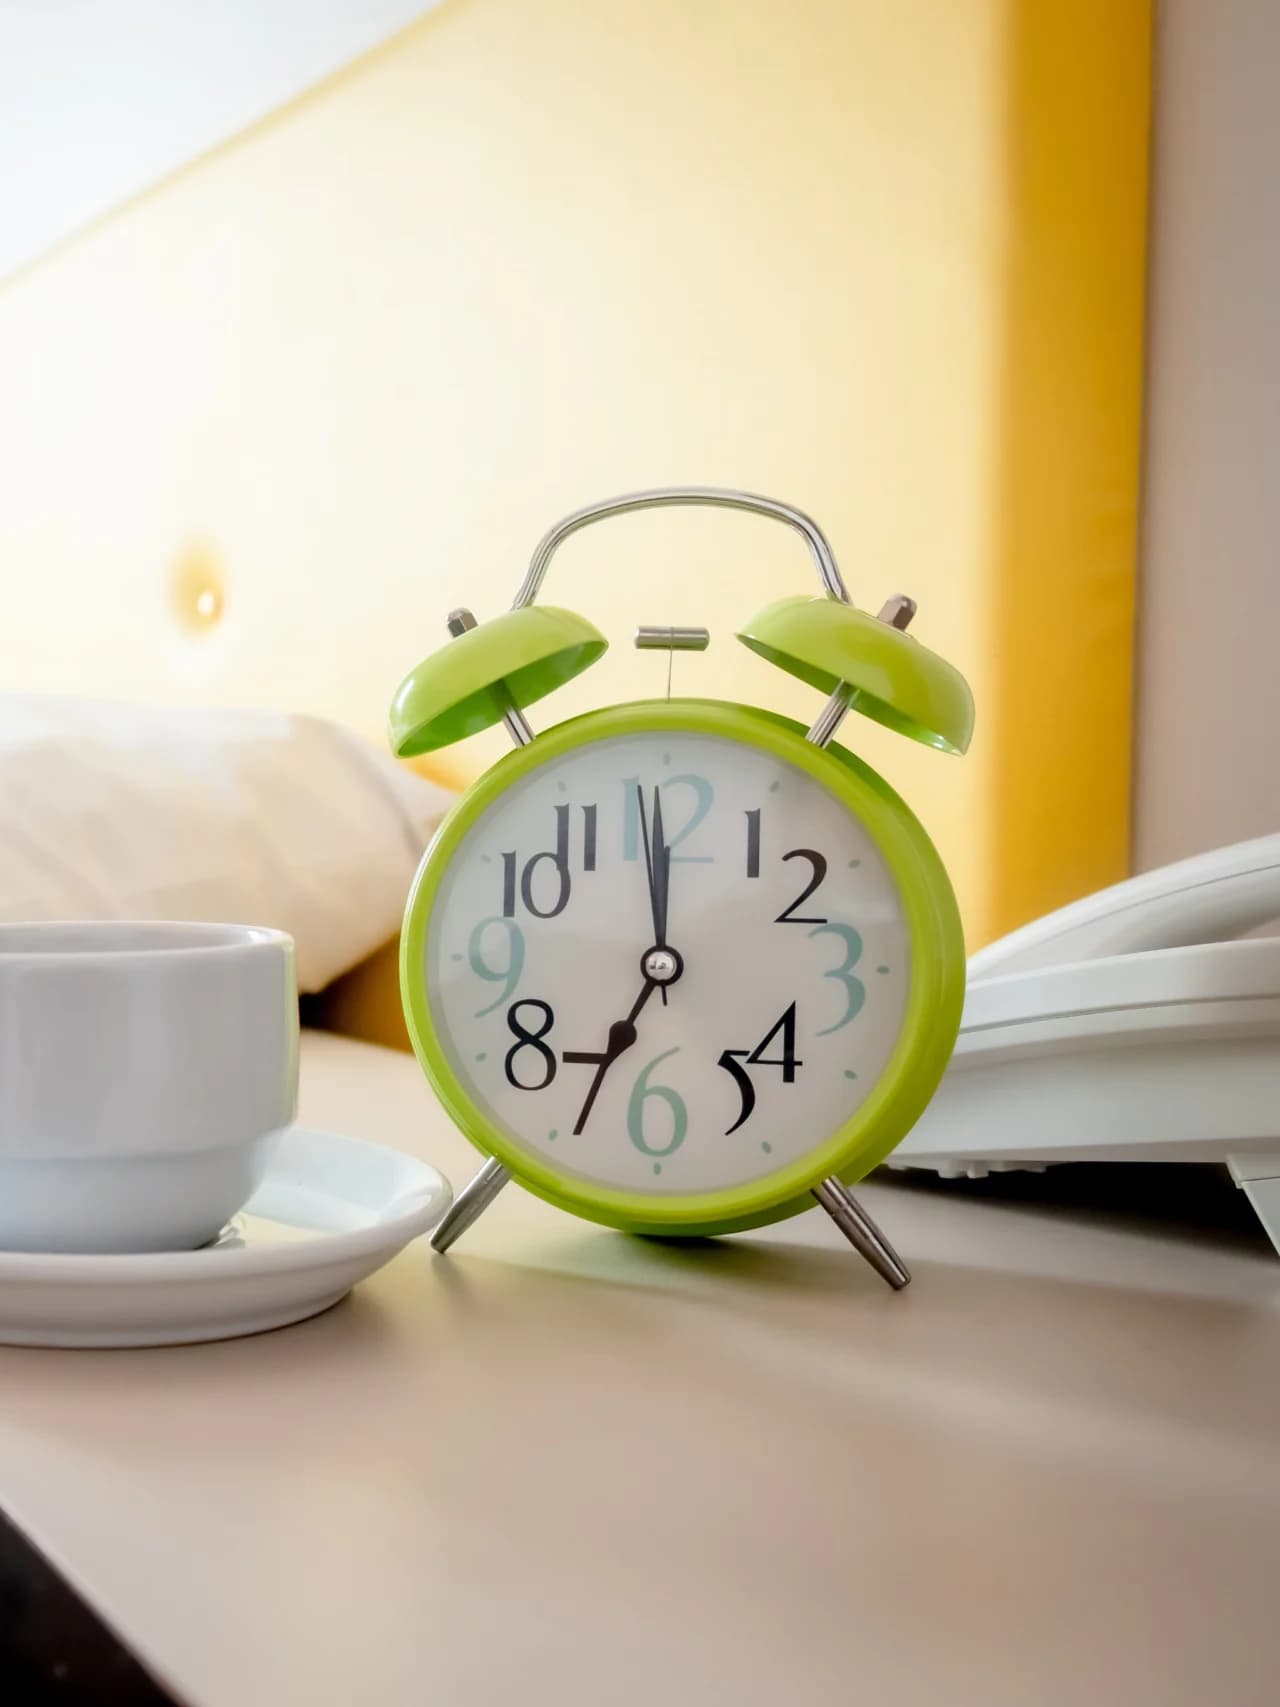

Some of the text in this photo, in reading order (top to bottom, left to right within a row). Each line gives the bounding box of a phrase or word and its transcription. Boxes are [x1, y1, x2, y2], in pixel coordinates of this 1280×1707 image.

[553, 802, 598, 872] 11
[622, 774, 715, 863] 12
[744, 808, 761, 878] 1
[501, 850, 572, 919] 10
[774, 849, 828, 924] 2
[467, 916, 526, 1019] 9
[807, 923, 866, 1037] 3
[504, 998, 557, 1091] 8
[746, 1000, 803, 1083] 4
[562, 1051, 612, 1136] 7
[626, 1046, 689, 1157] 6
[716, 1049, 756, 1136] 5
